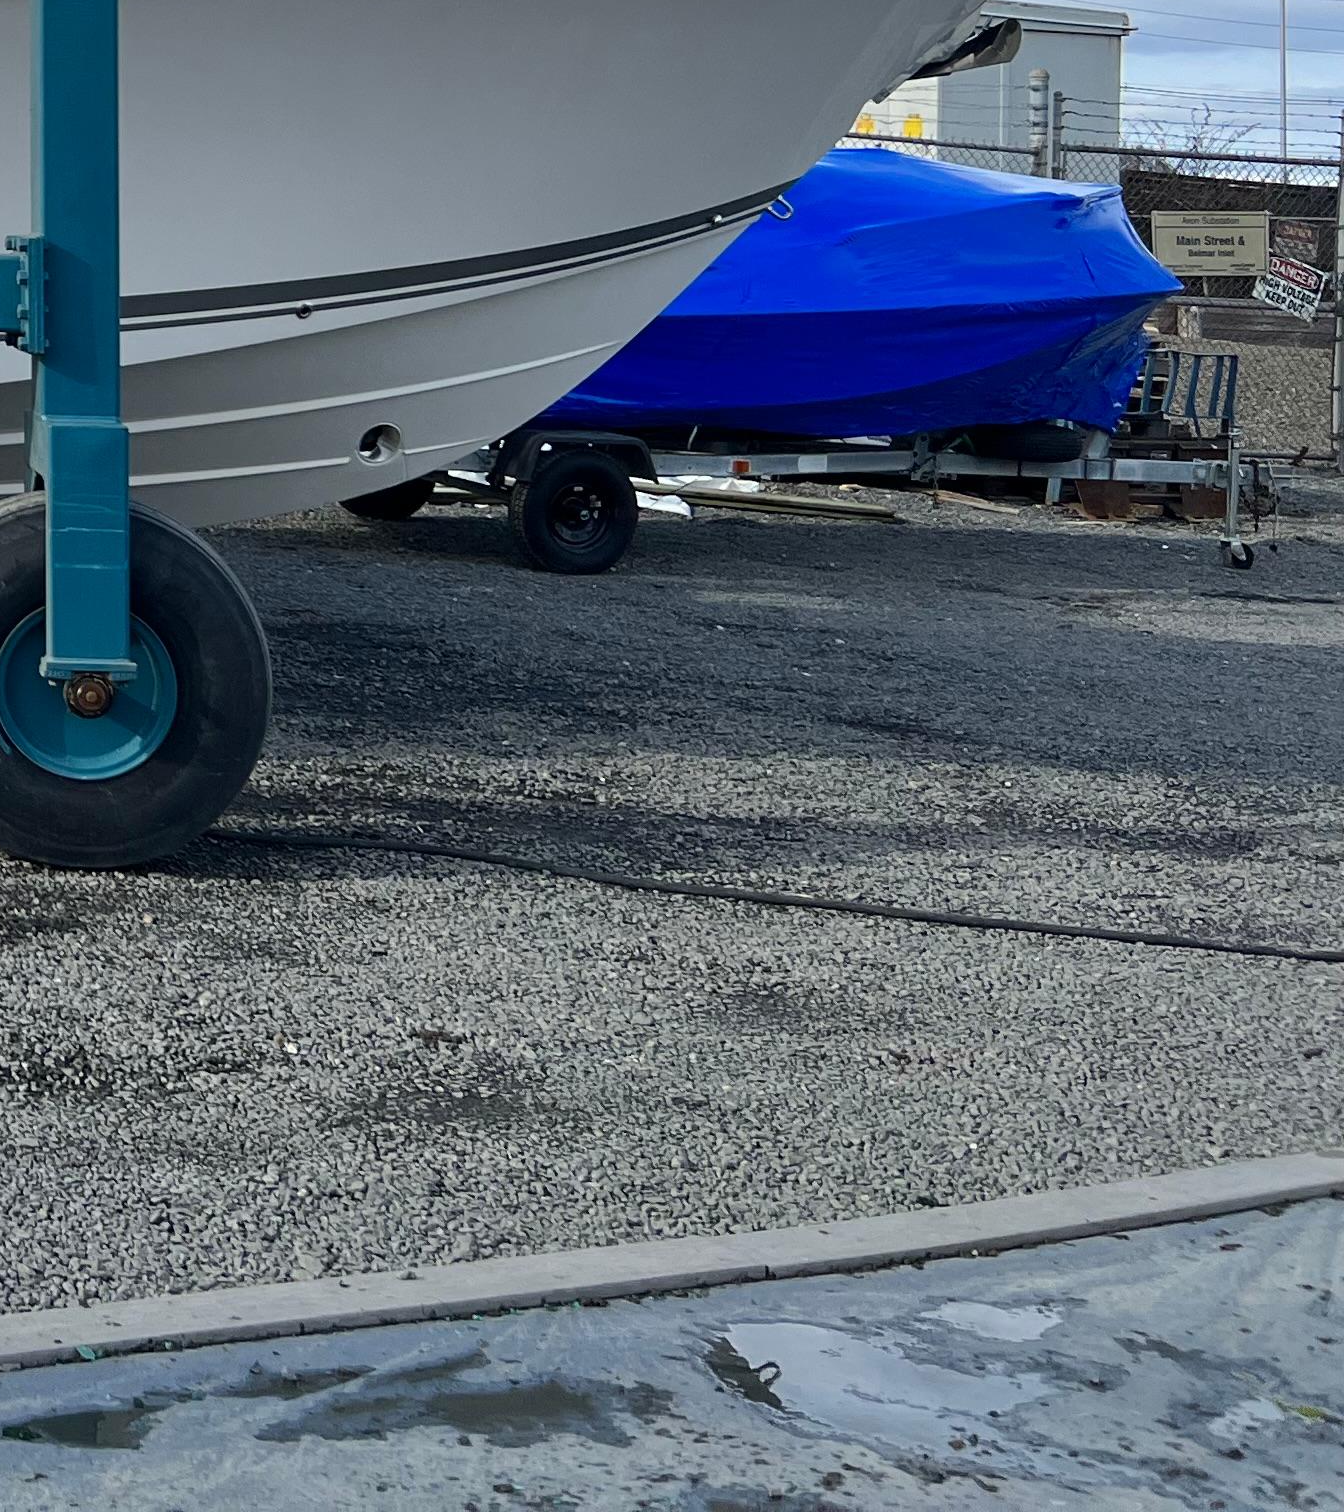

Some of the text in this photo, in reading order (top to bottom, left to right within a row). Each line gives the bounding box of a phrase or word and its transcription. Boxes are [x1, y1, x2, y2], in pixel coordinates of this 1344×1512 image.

[1176, 235, 1246, 246] Main Street &
[1272, 257, 1318, 289] DANGER
[1265, 289, 1305, 314] KEEP OUT
